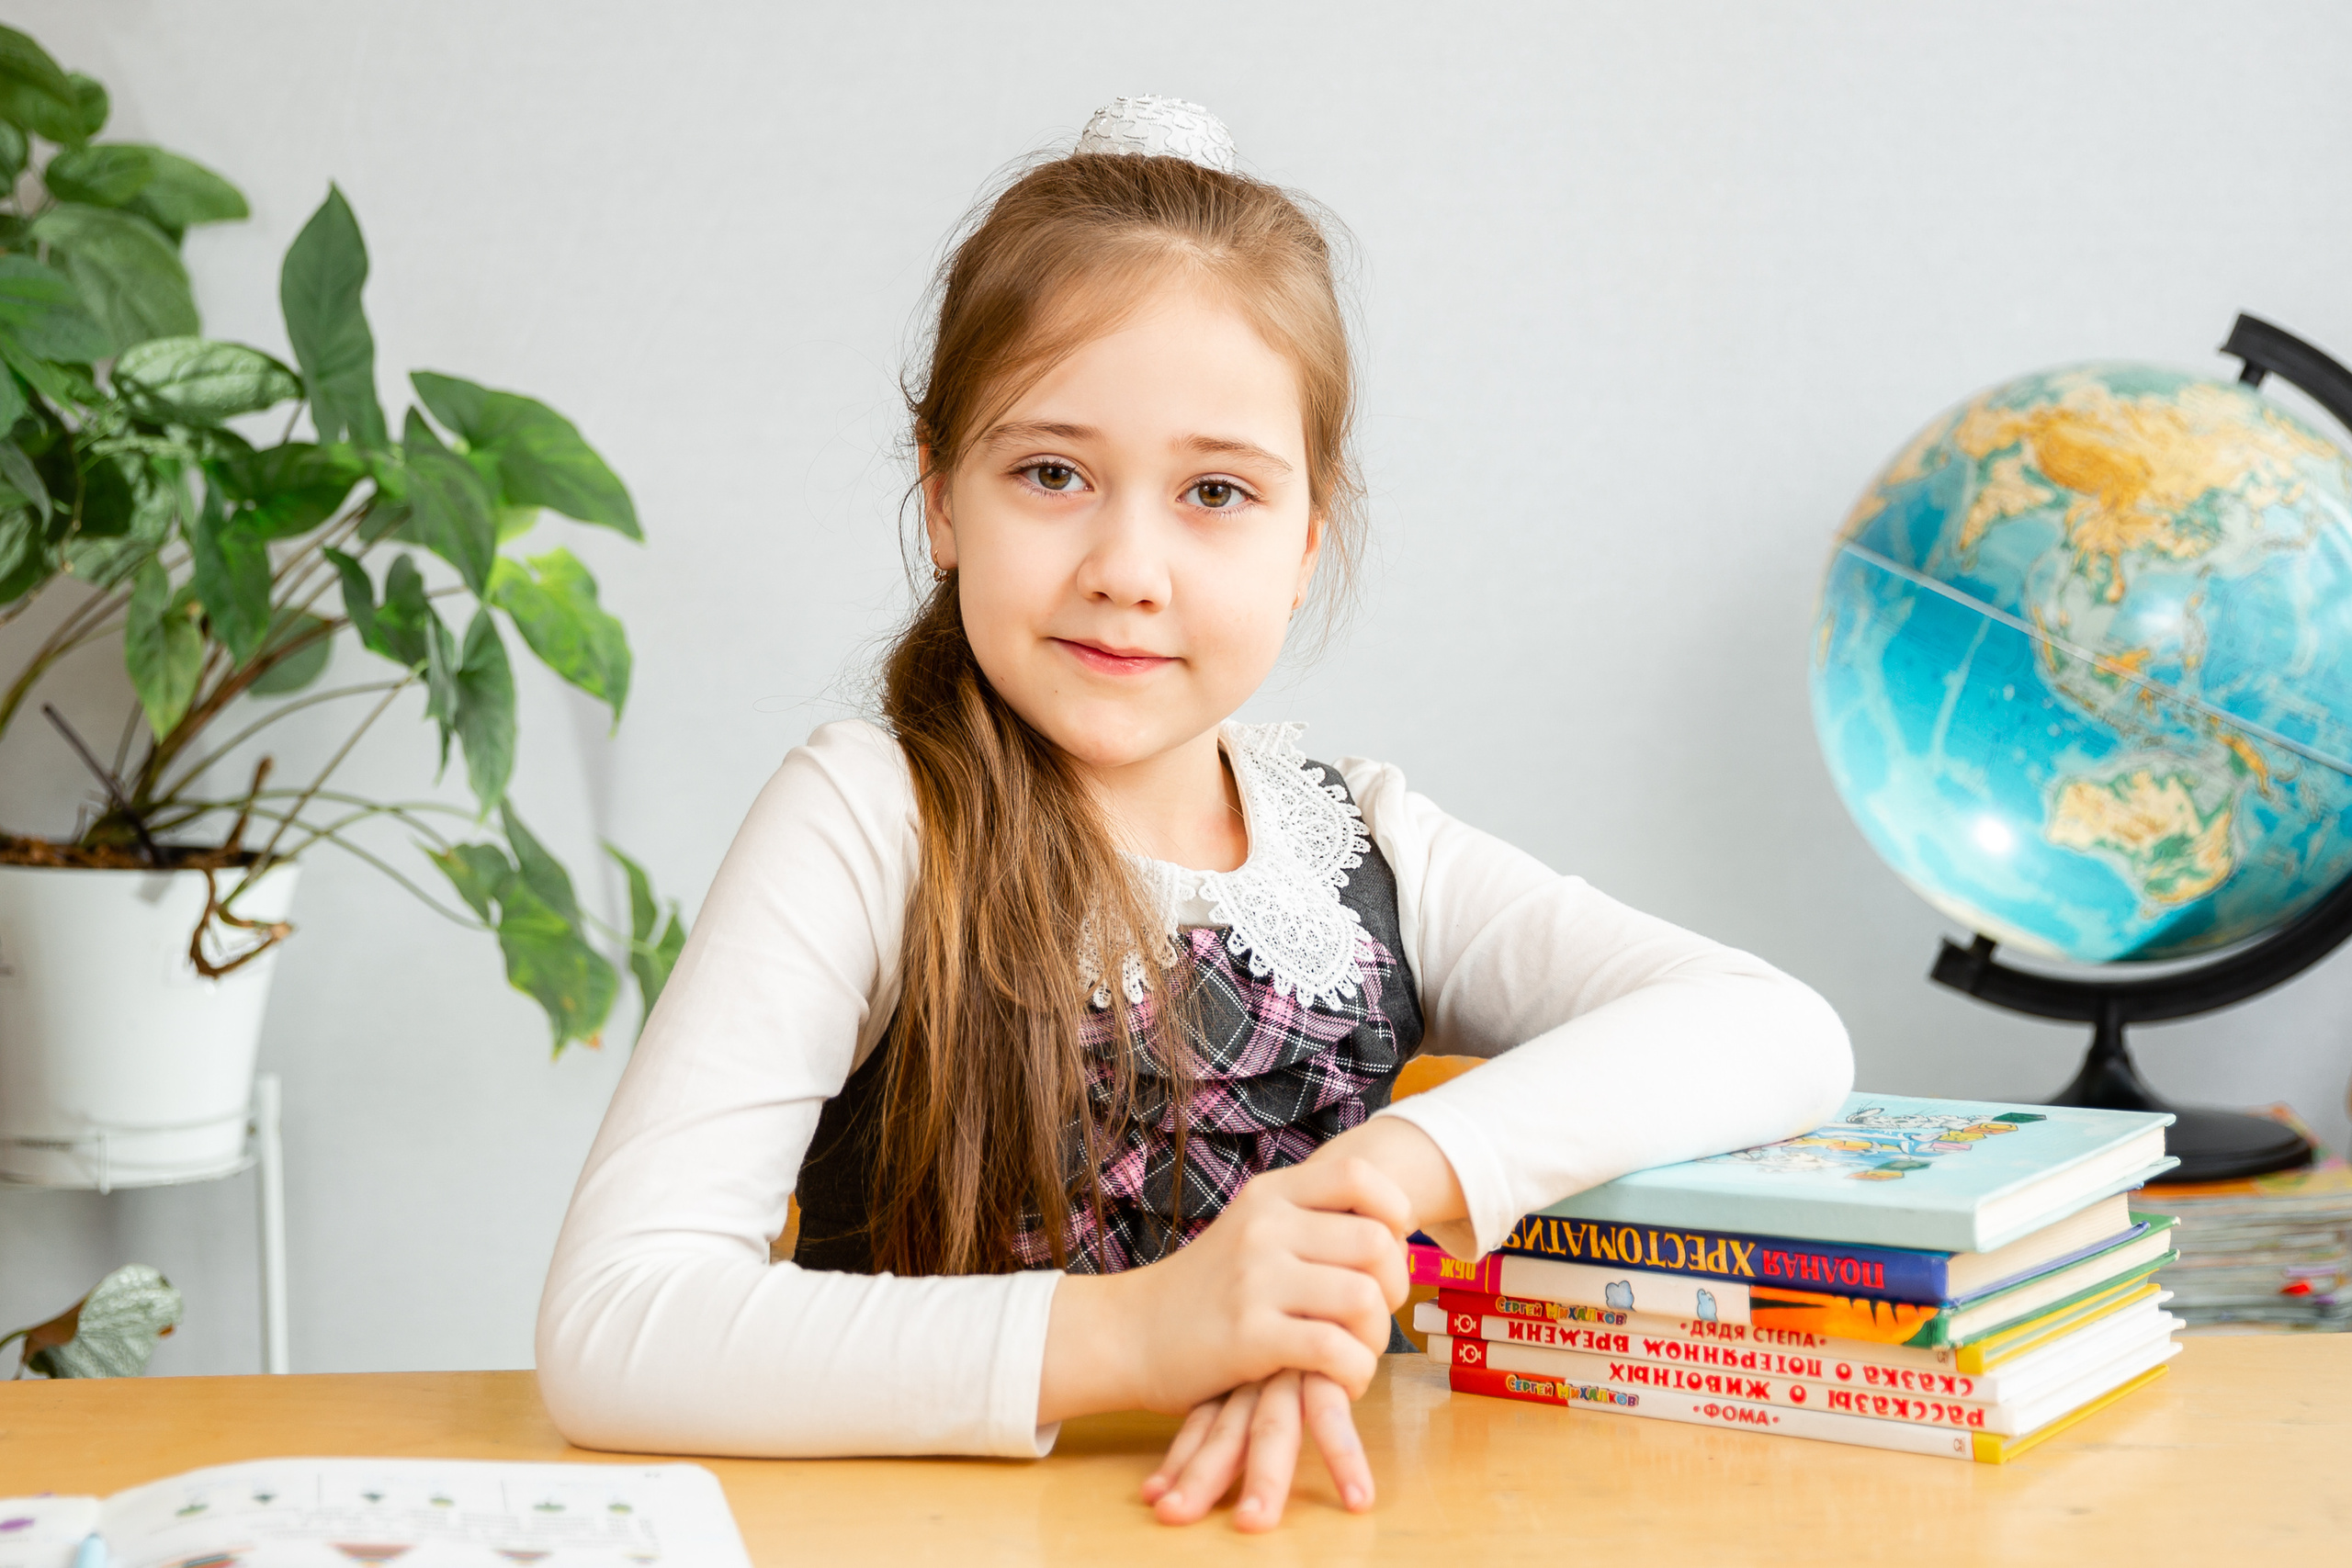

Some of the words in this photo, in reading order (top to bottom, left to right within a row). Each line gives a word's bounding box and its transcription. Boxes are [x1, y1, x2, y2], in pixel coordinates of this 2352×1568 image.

[1762, 1249, 1884, 1289] ПОЛНАЯ
[1496, 1296, 1544, 1317] СЕРГЕЙ
[1545, 1302, 1627, 1326] МИХАЛКОВ
[1690, 1320, 1746, 1343] ДЯДЯ
[1753, 1327, 1816, 1348] СТЕПА
[1505, 1374, 1555, 1396] СЕРГЕЙ
[1556, 1382, 1640, 1407] МИХАЛКОВ
[1703, 1403, 1770, 1426] ФОМА
